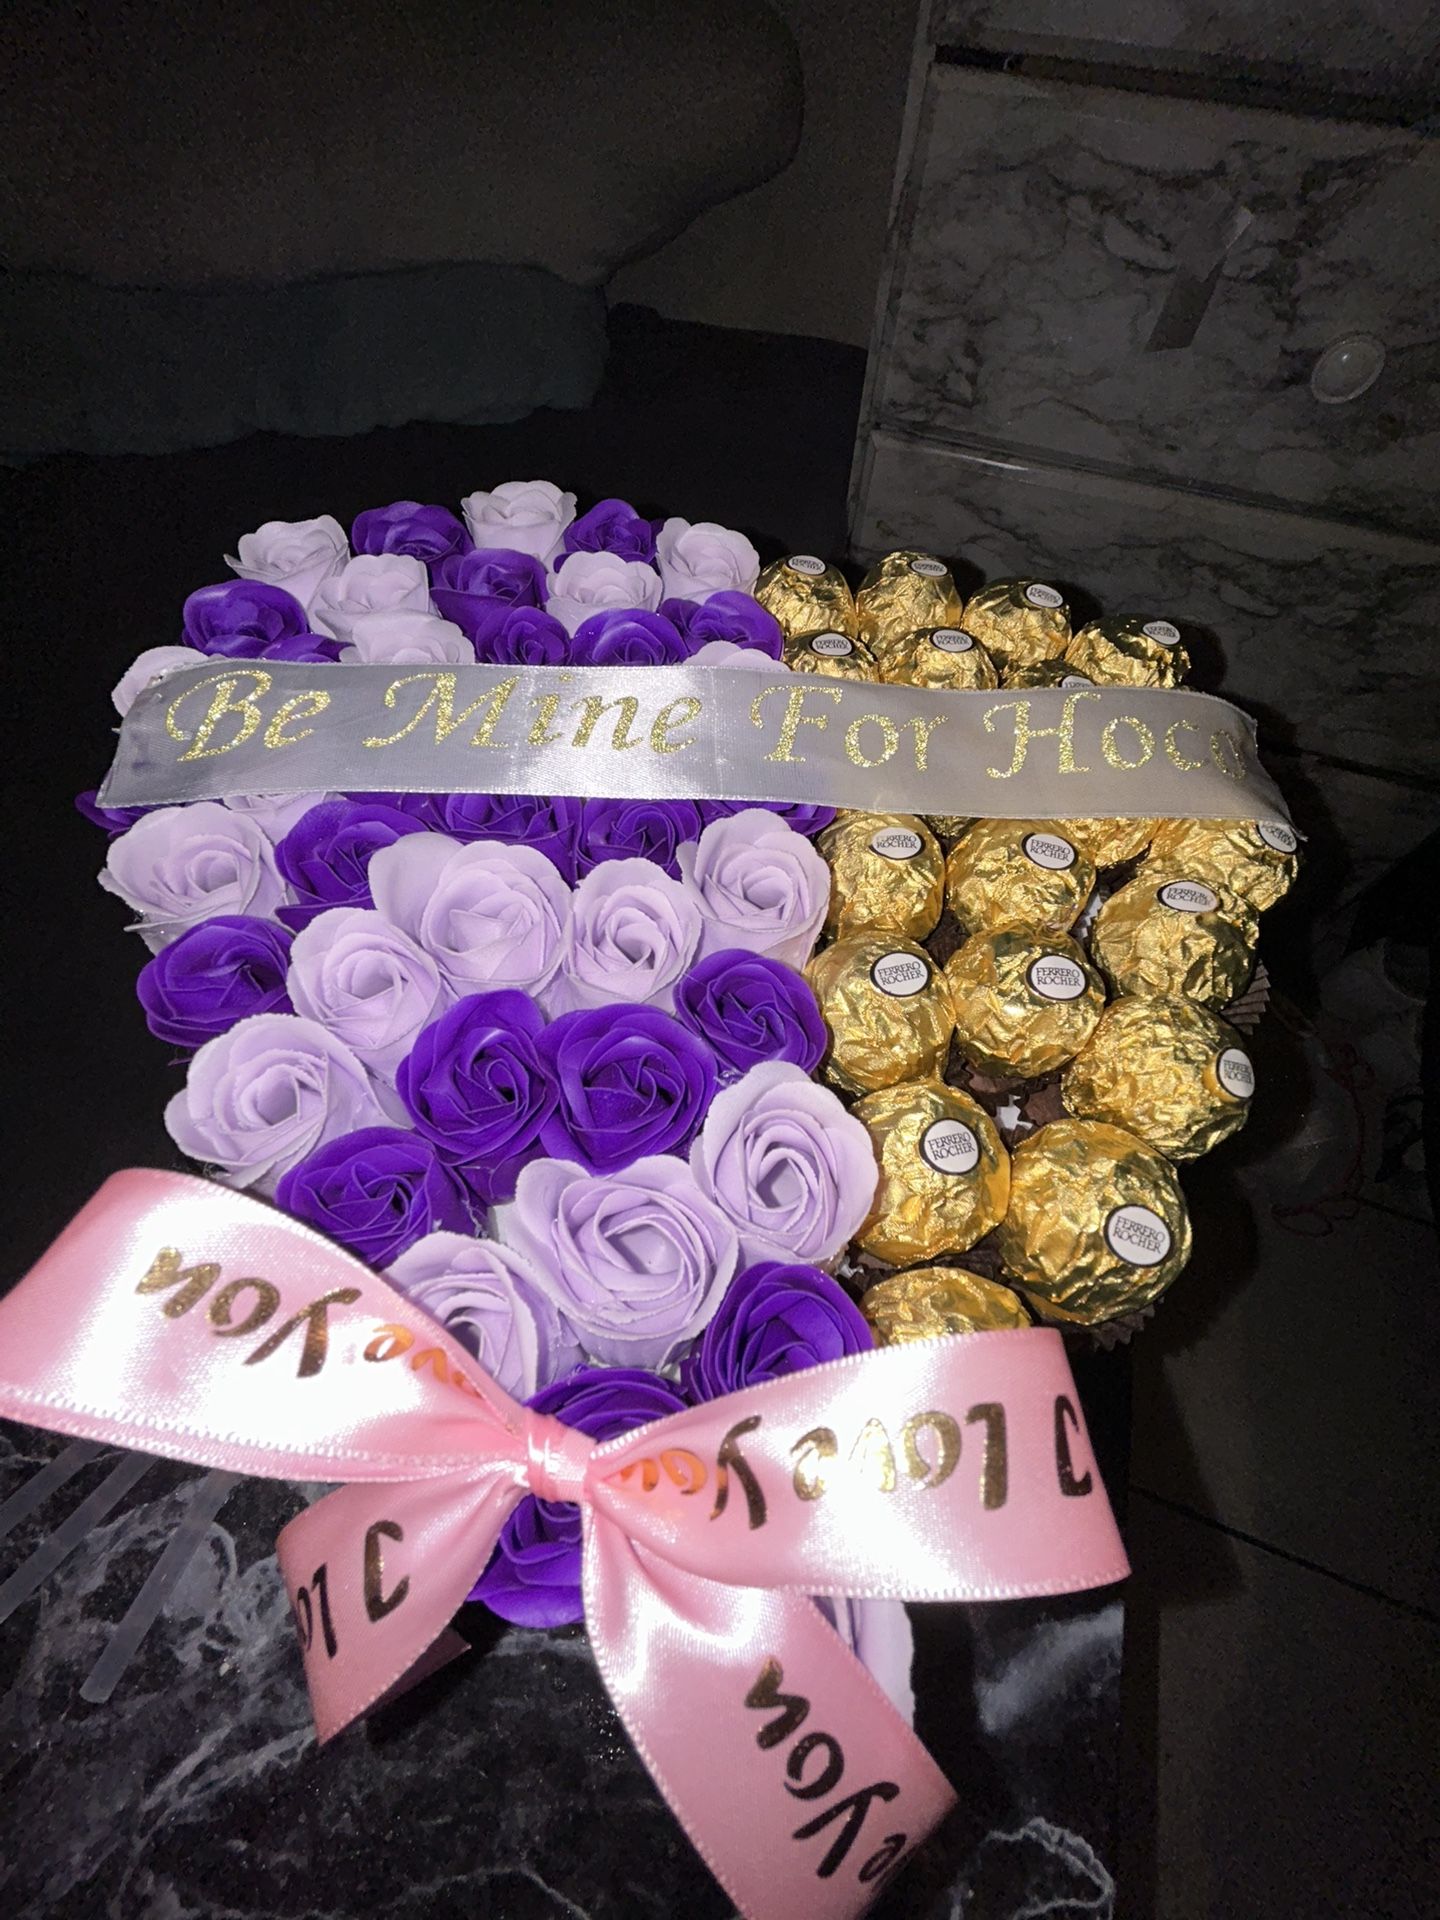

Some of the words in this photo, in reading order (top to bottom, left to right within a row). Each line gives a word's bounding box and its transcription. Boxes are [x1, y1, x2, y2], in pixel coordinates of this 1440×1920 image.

[165, 669, 331, 762] Be
[362, 671, 703, 754] Mine
[749, 684, 949, 773] For
[983, 691, 1247, 780] Hoco
[1031, 839, 1070, 854] FERRERO
[1030, 848, 1069, 861] ROCHER
[878, 962, 920, 977] FERRERO
[1036, 968, 1080, 977] FERRERO
[882, 970, 924, 985] ROCHER
[1038, 977, 1081, 987] ROCHER
[928, 1132, 971, 1149] FERRERO
[933, 1143, 975, 1160] ROCHER
[1116, 1216, 1165, 1242] FERRERO
[1114, 1229, 1161, 1253] ROCHER
